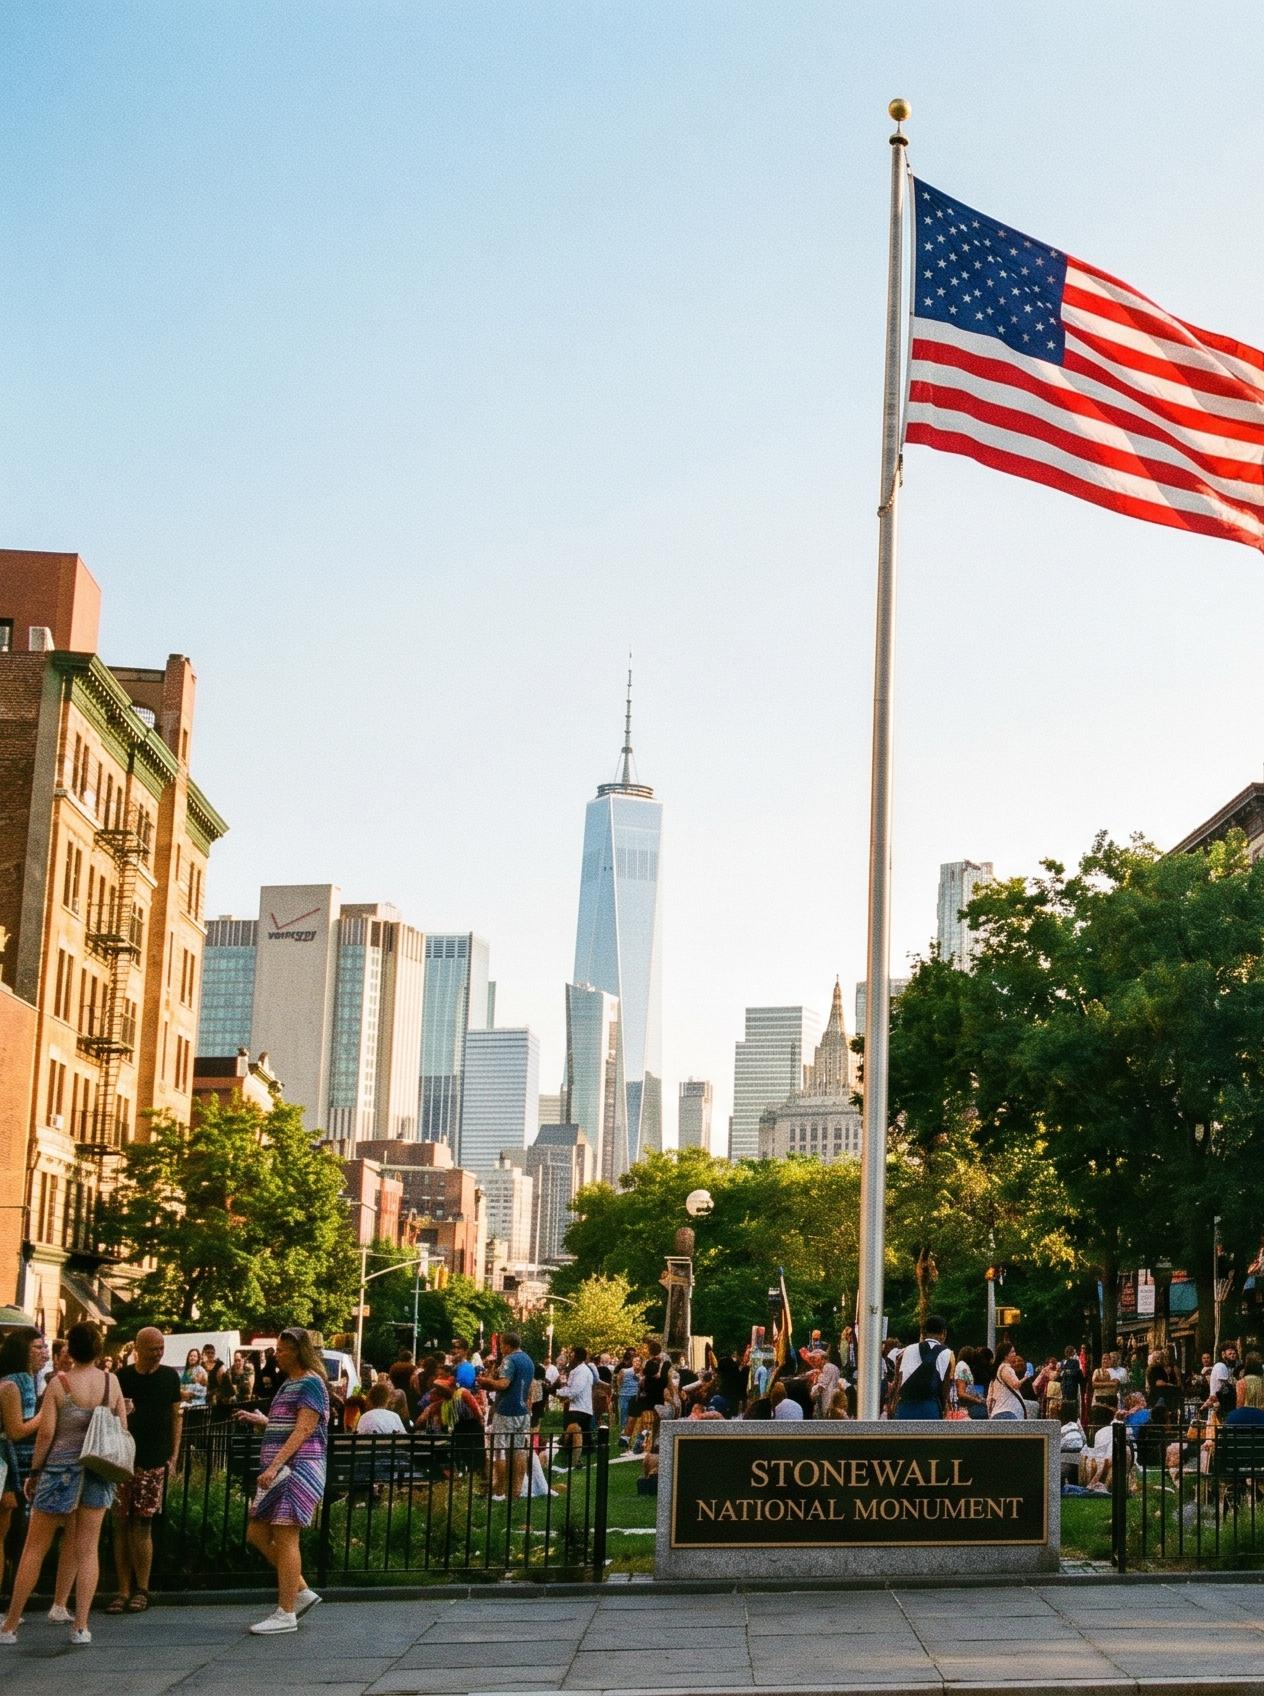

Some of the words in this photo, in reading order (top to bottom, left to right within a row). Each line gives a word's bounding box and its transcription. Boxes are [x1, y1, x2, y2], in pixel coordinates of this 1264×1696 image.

[750, 1459, 973, 1488] STONEWALL
[696, 1499, 845, 1522] NATIONAL
[853, 1497, 1024, 1521] MONUMENT
